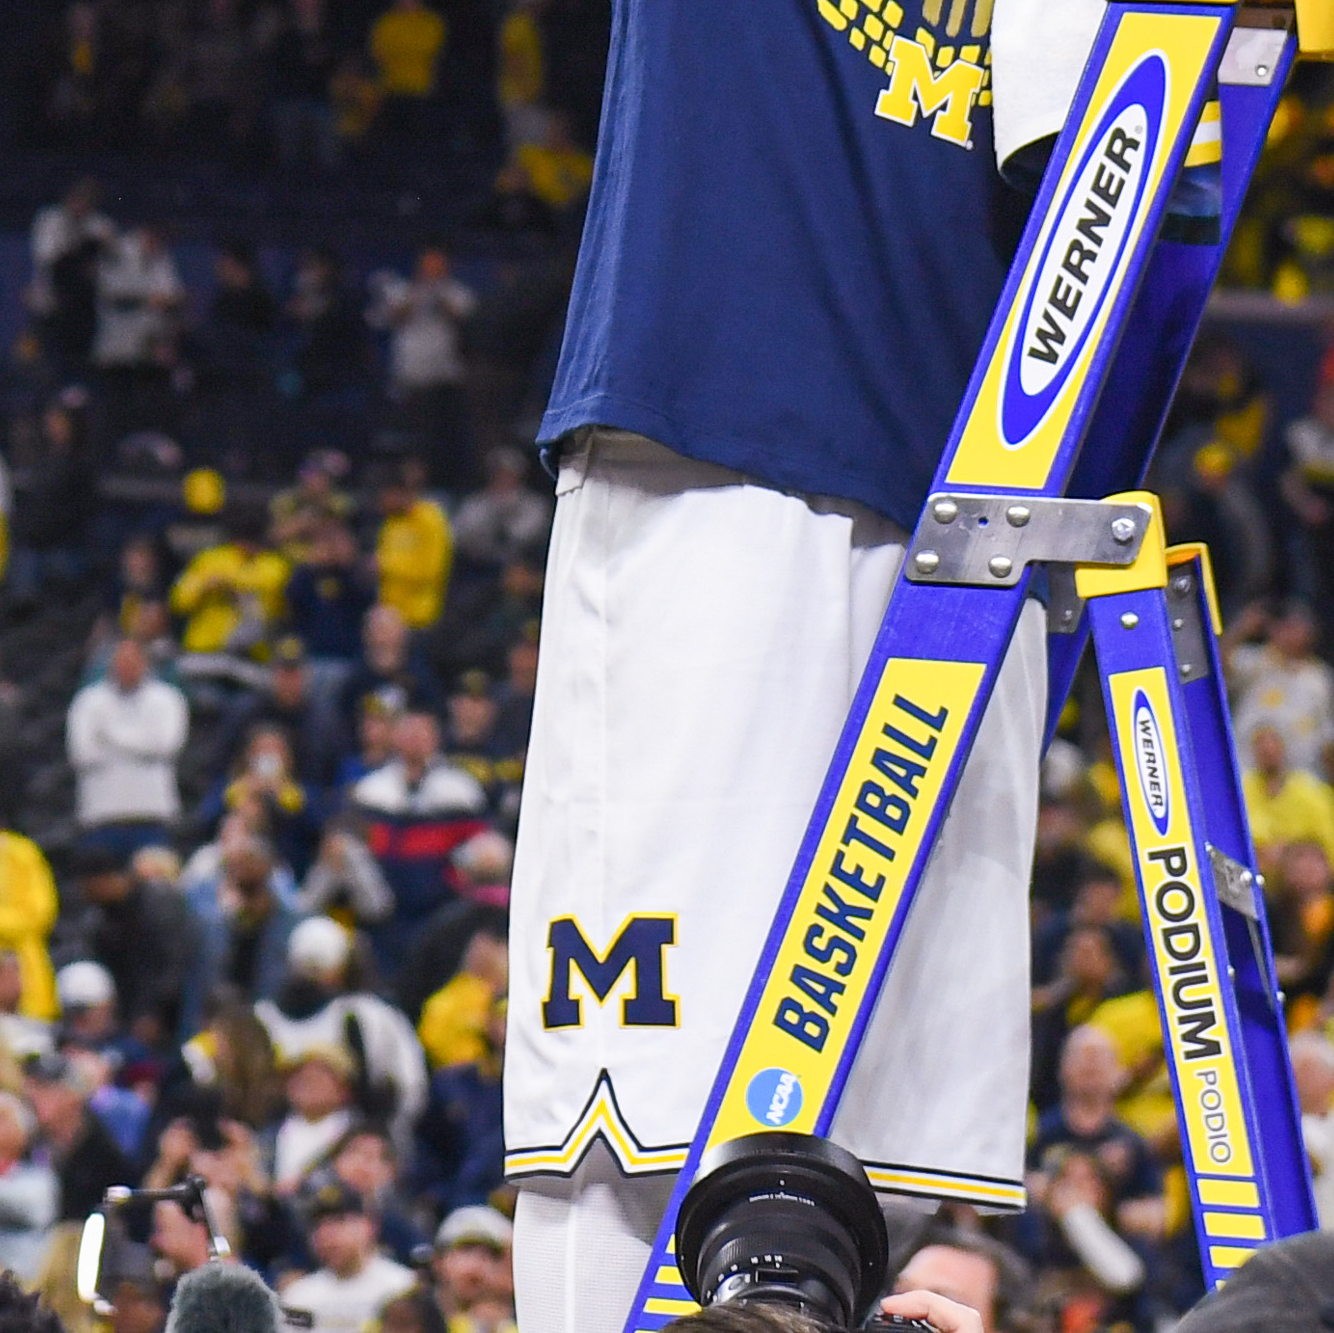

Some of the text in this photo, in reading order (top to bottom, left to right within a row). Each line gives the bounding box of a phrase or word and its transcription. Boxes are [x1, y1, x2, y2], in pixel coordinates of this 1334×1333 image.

[875, 35, 984, 147] M
[1027, 127, 1141, 365] WERNER
[1138, 718, 1164, 809] WERNER
[772, 693, 949, 1054] BASKETBALL
[541, 912, 681, 1032] M
[1148, 847, 1222, 1061] PODIUM
[766, 1072, 798, 1125] NCAA
[1196, 1070, 1231, 1165] PODIO
